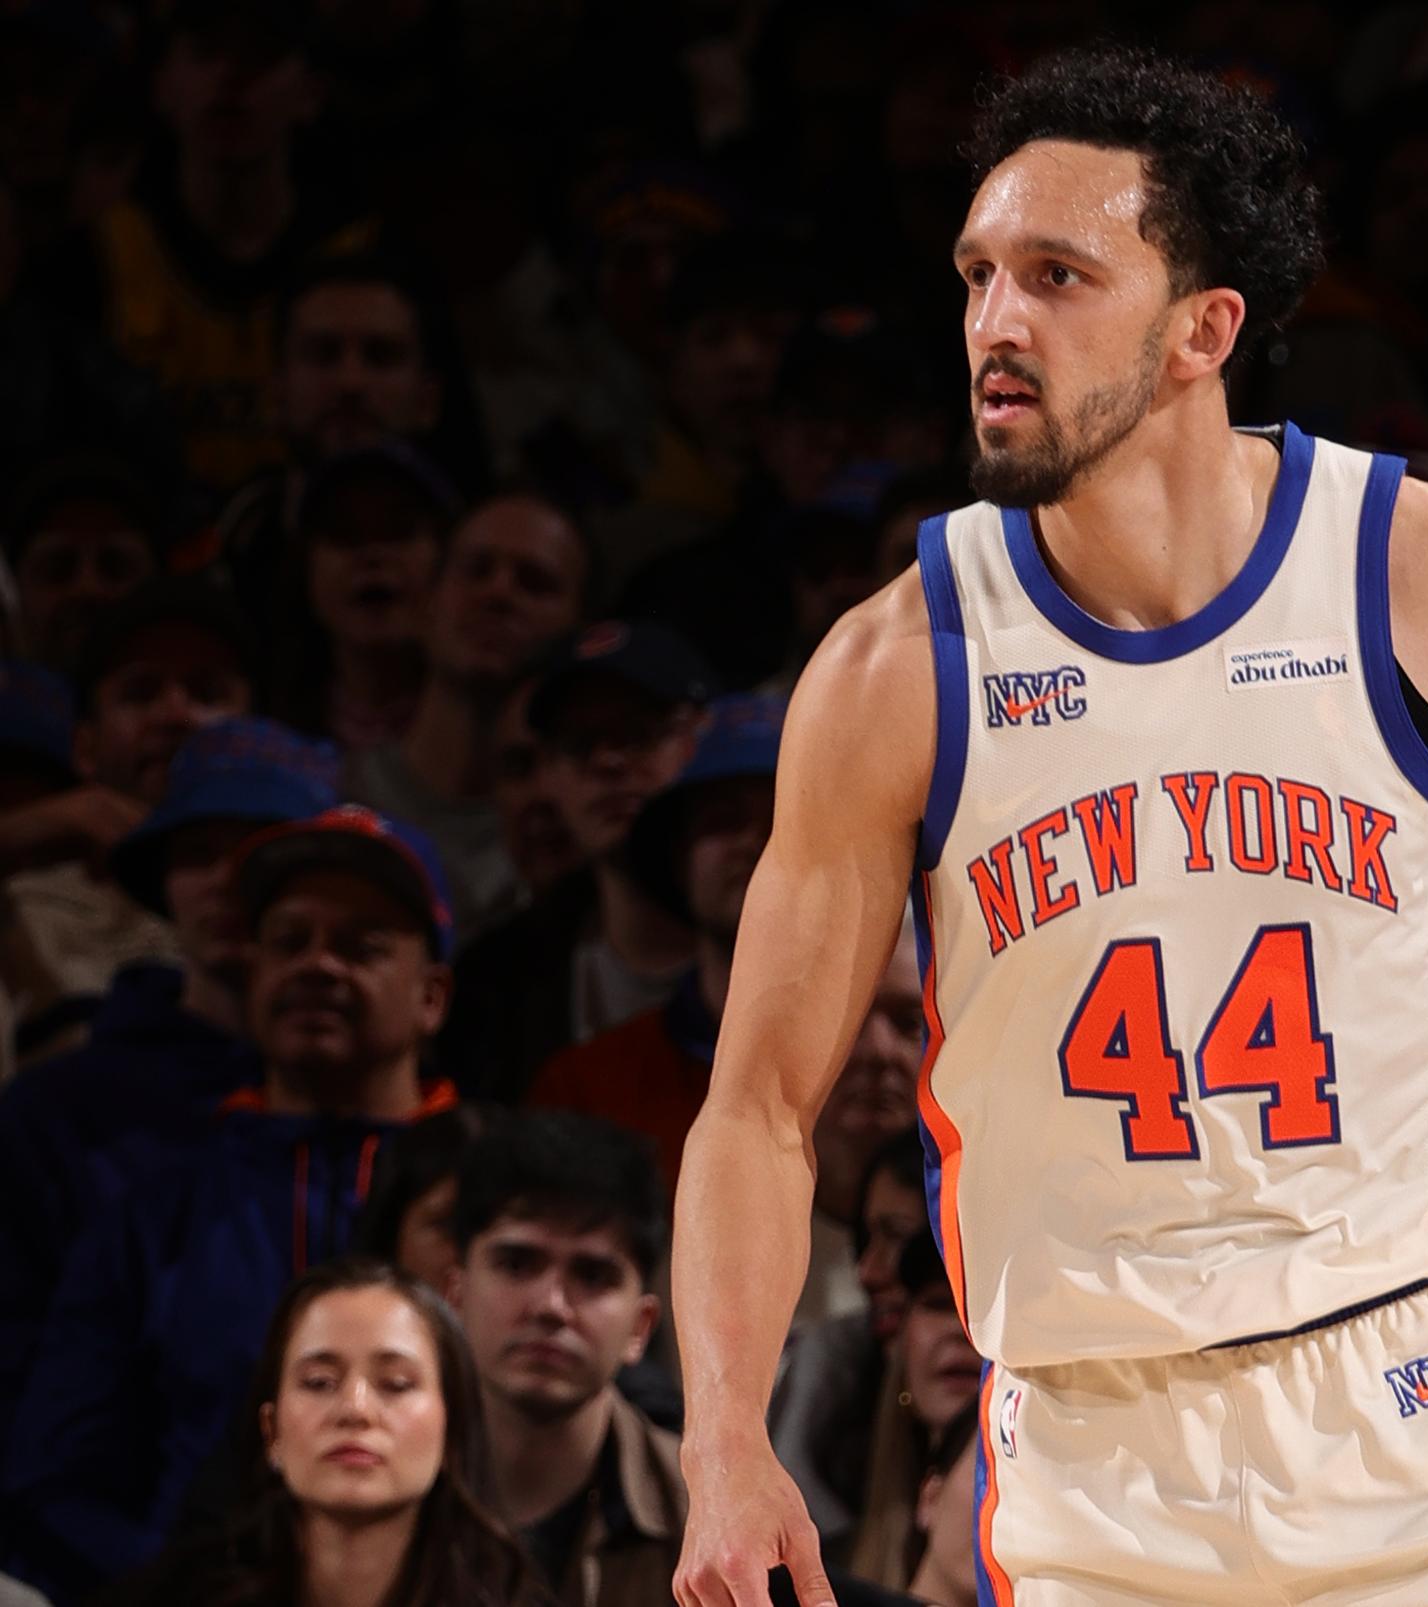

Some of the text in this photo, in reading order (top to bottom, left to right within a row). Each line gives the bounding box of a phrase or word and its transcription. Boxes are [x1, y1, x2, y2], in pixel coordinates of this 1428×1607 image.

[1231, 649, 1293, 663] experience
[1231, 654, 1348, 684] abu dhabi
[984, 666, 1086, 728] NYC
[967, 771, 1398, 956] NEW YORK
[1057, 921, 1342, 1161] 44
